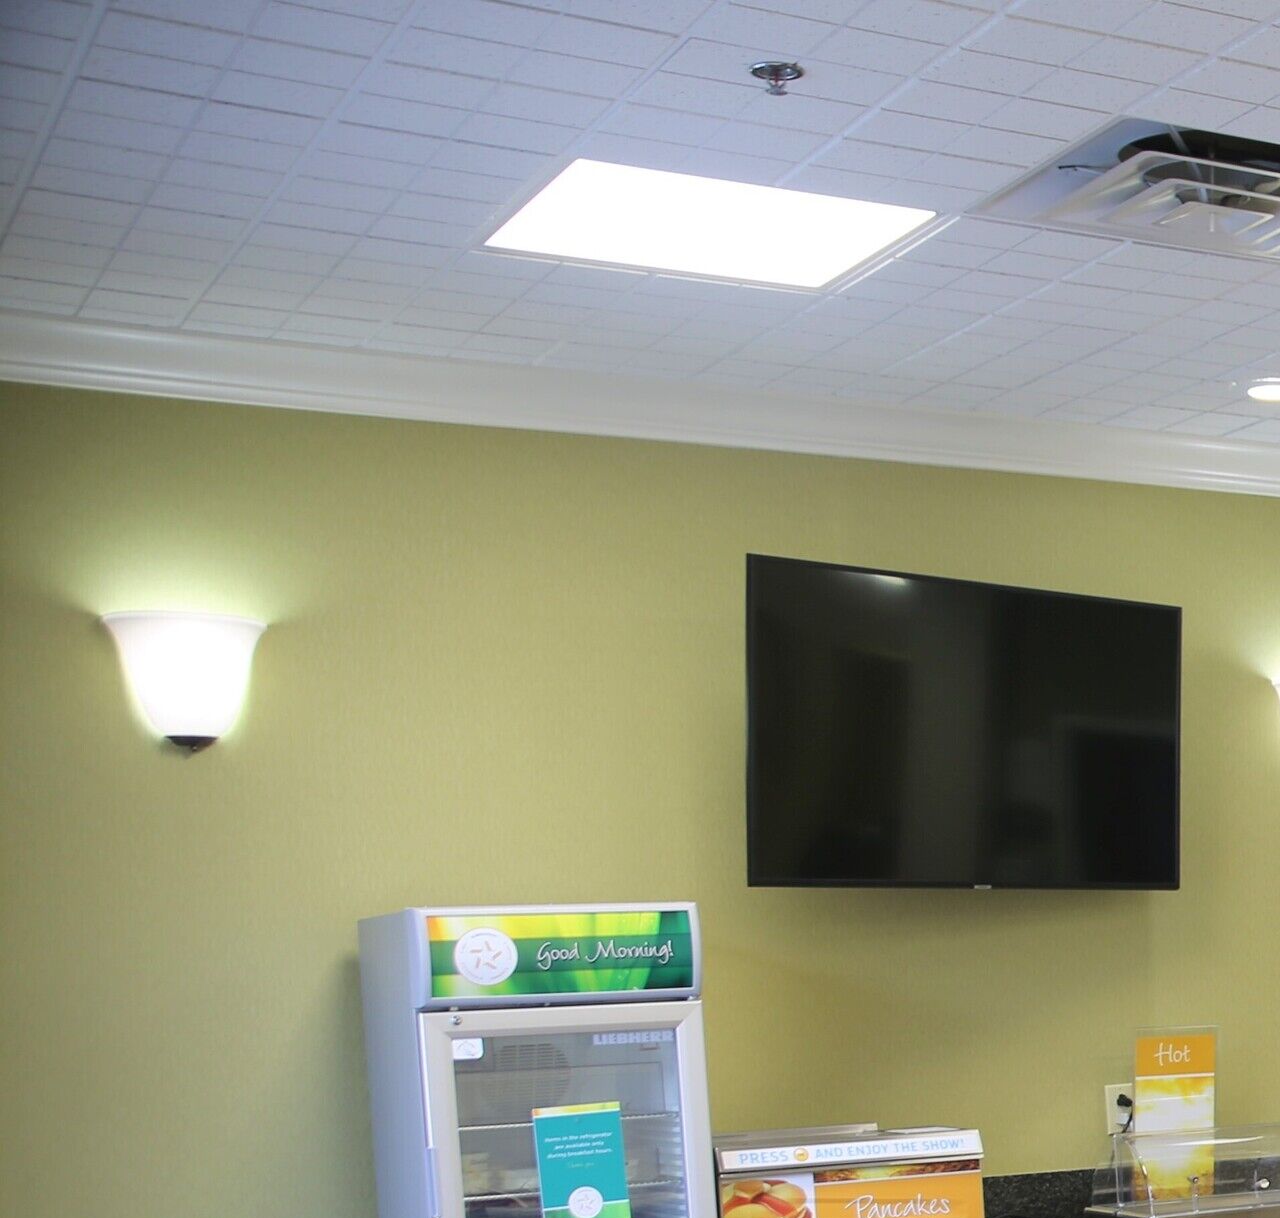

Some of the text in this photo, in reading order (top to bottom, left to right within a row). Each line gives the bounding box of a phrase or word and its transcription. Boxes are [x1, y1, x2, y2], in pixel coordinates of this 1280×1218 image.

[536, 939, 674, 971] Good Morning!
[593, 1030, 675, 1046] LIEBHERR
[1153, 1042, 1191, 1067] Hot
[738, 1137, 966, 1165] PRESS AND ENJOY THE SHOW!
